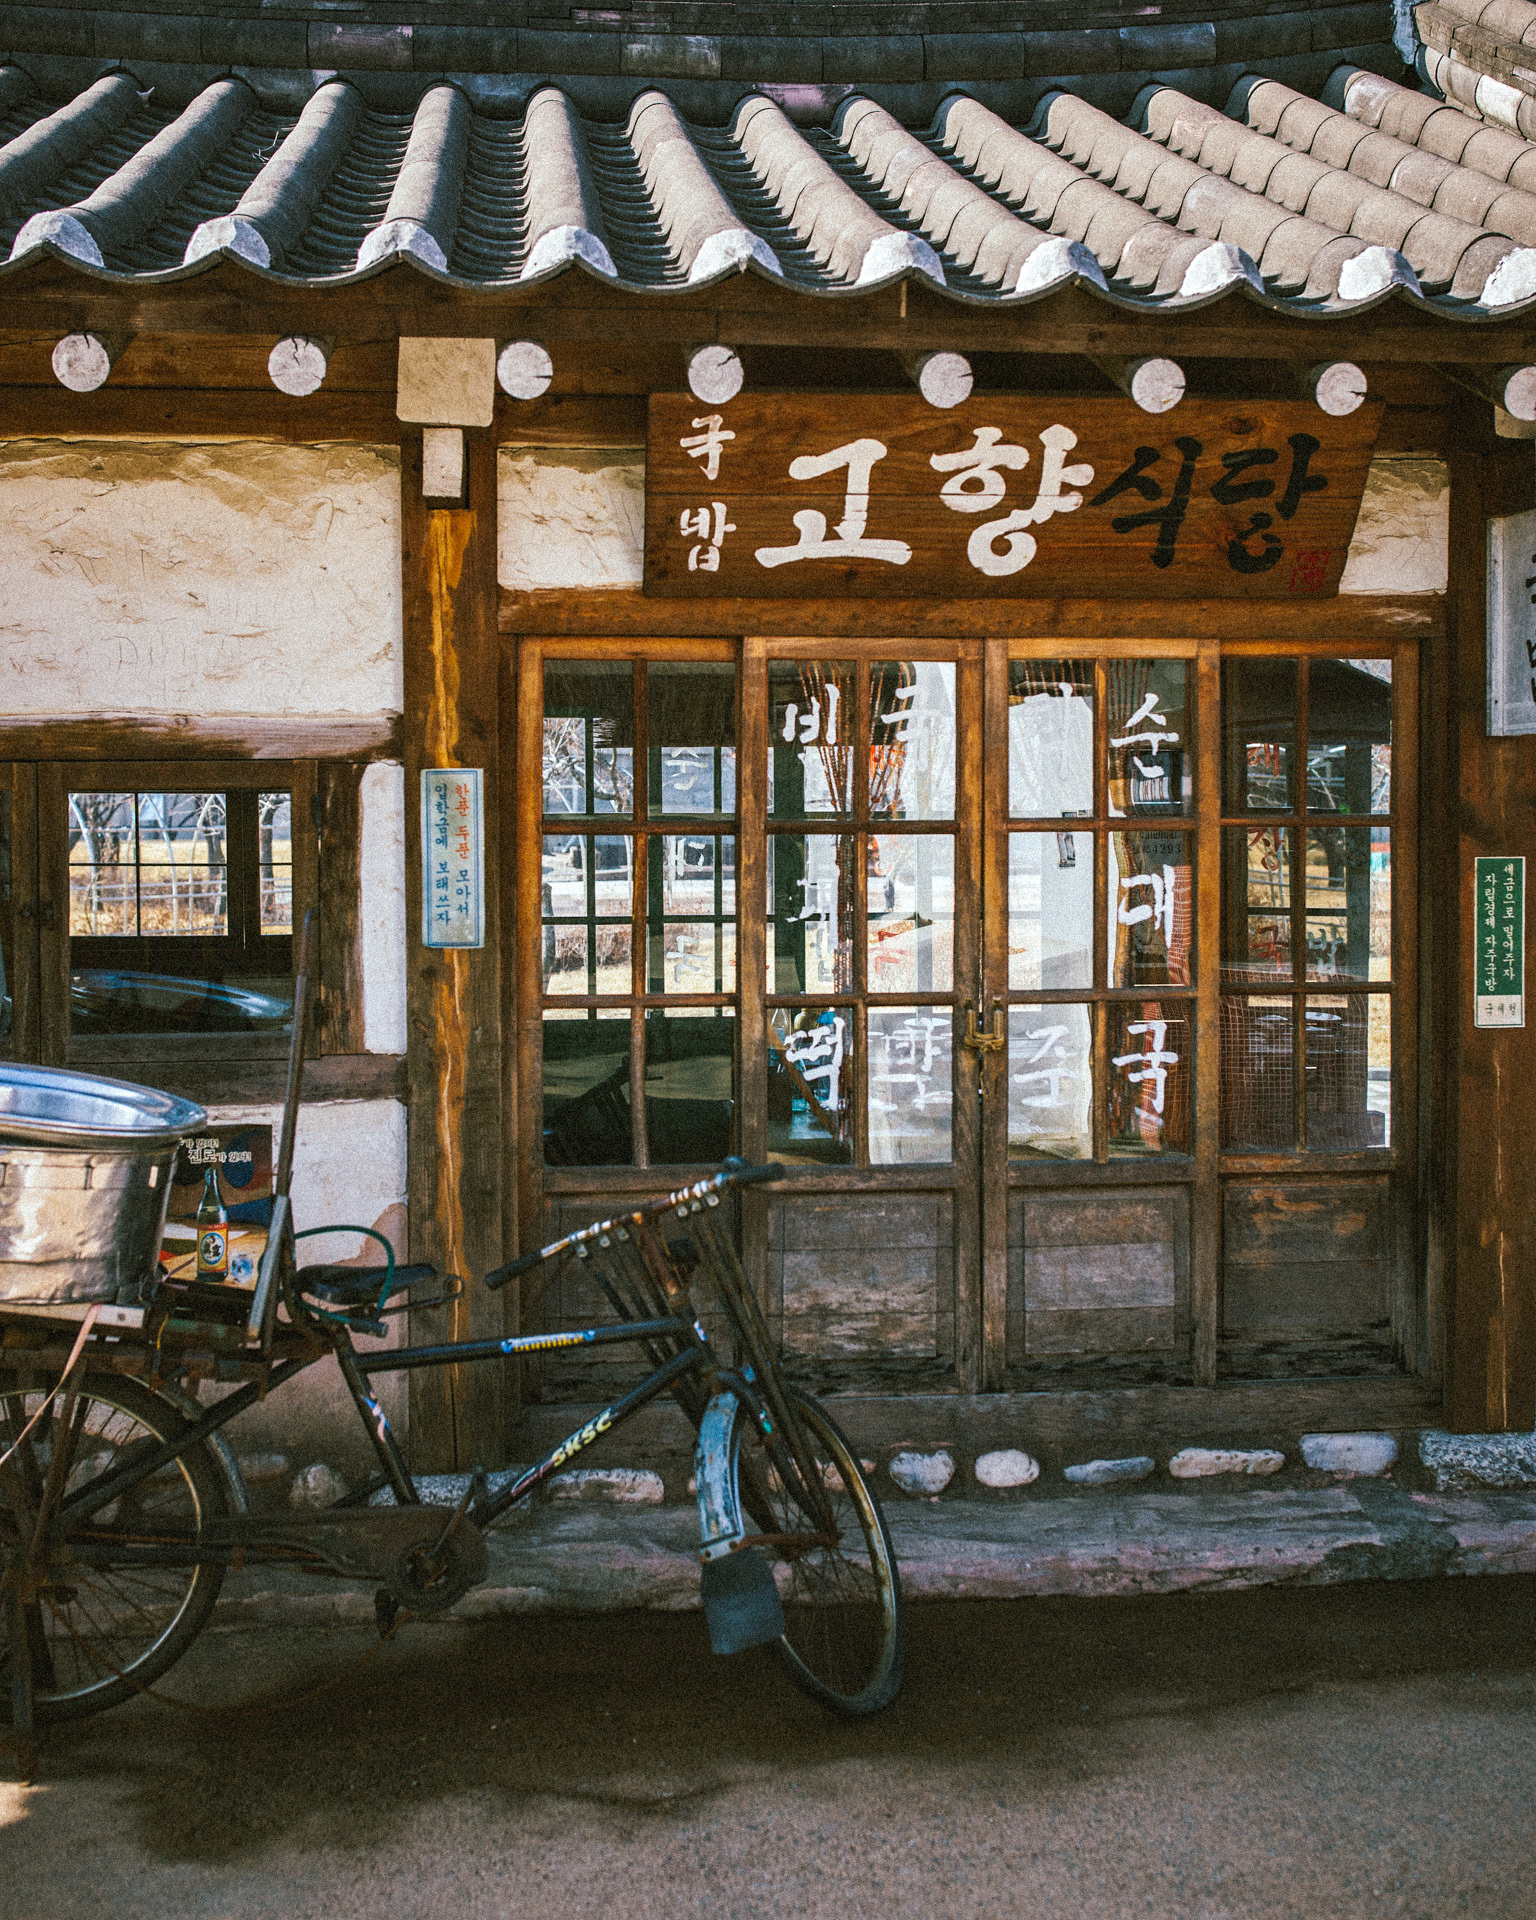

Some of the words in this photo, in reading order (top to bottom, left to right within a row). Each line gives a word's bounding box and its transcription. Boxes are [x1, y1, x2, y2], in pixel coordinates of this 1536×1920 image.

[680, 414, 737, 572] 국밥
[456, 868, 472, 917] 모아서
[1110, 693, 1179, 1114] 순대국
